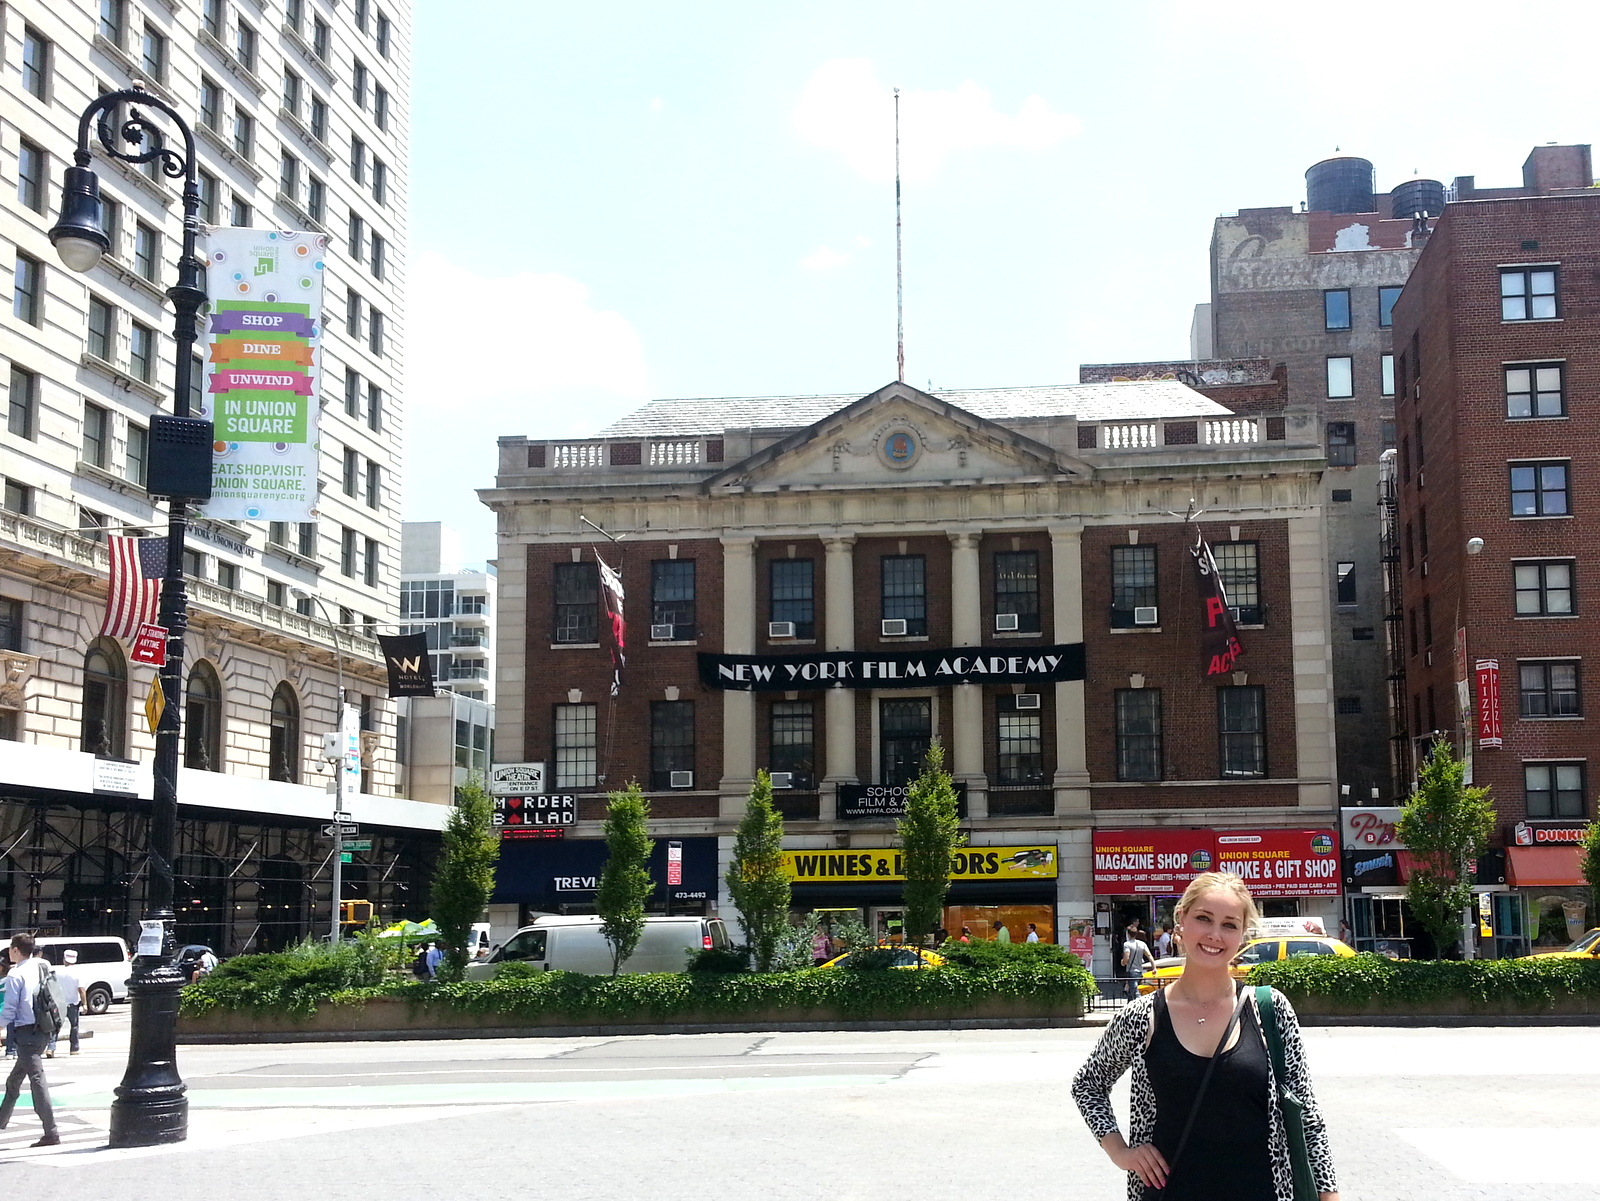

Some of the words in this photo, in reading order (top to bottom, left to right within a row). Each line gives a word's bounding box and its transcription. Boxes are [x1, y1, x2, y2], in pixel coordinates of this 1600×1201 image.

[242, 315, 283, 326] SHOP
[243, 343, 281, 355] DINE
[229, 374, 294, 386] UNWIND
[224, 400, 240, 415] IN
[246, 401, 297, 417] UNION
[227, 418, 294, 434] SQUARE
[252, 480, 306, 491] SQUARE.
[194, 526, 210, 541] YORK
[140, 638, 161, 650] ANYTIME
[390, 655, 421, 674] W
[718, 663, 775, 682] NEW
[784, 660, 854, 681] YORK
[862, 660, 928, 679] FILM
[934, 654, 1063, 676] ACADEMY
[1481, 674, 1491, 734] PIZZA
[495, 768, 514, 781] UNION
[515, 766, 540, 780] SQUARE
[866, 787, 911, 797] SCHOO
[858, 797, 885, 807] FILM
[889, 797, 898, 806] &
[1095, 854, 1155, 870] MAGAZINE
[1157, 853, 1188, 869] SHOP
[1252, 851, 1290, 859] SQUARE
[795, 854, 871, 877] WINES
[875, 859, 890, 875] &
[895, 853, 999, 876] LORS
[1219, 861, 1260, 879] SMOKE
[1263, 860, 1272, 878] &
[1275, 860, 1302, 878] GIFT
[1305, 859, 1337, 878] SHOP
